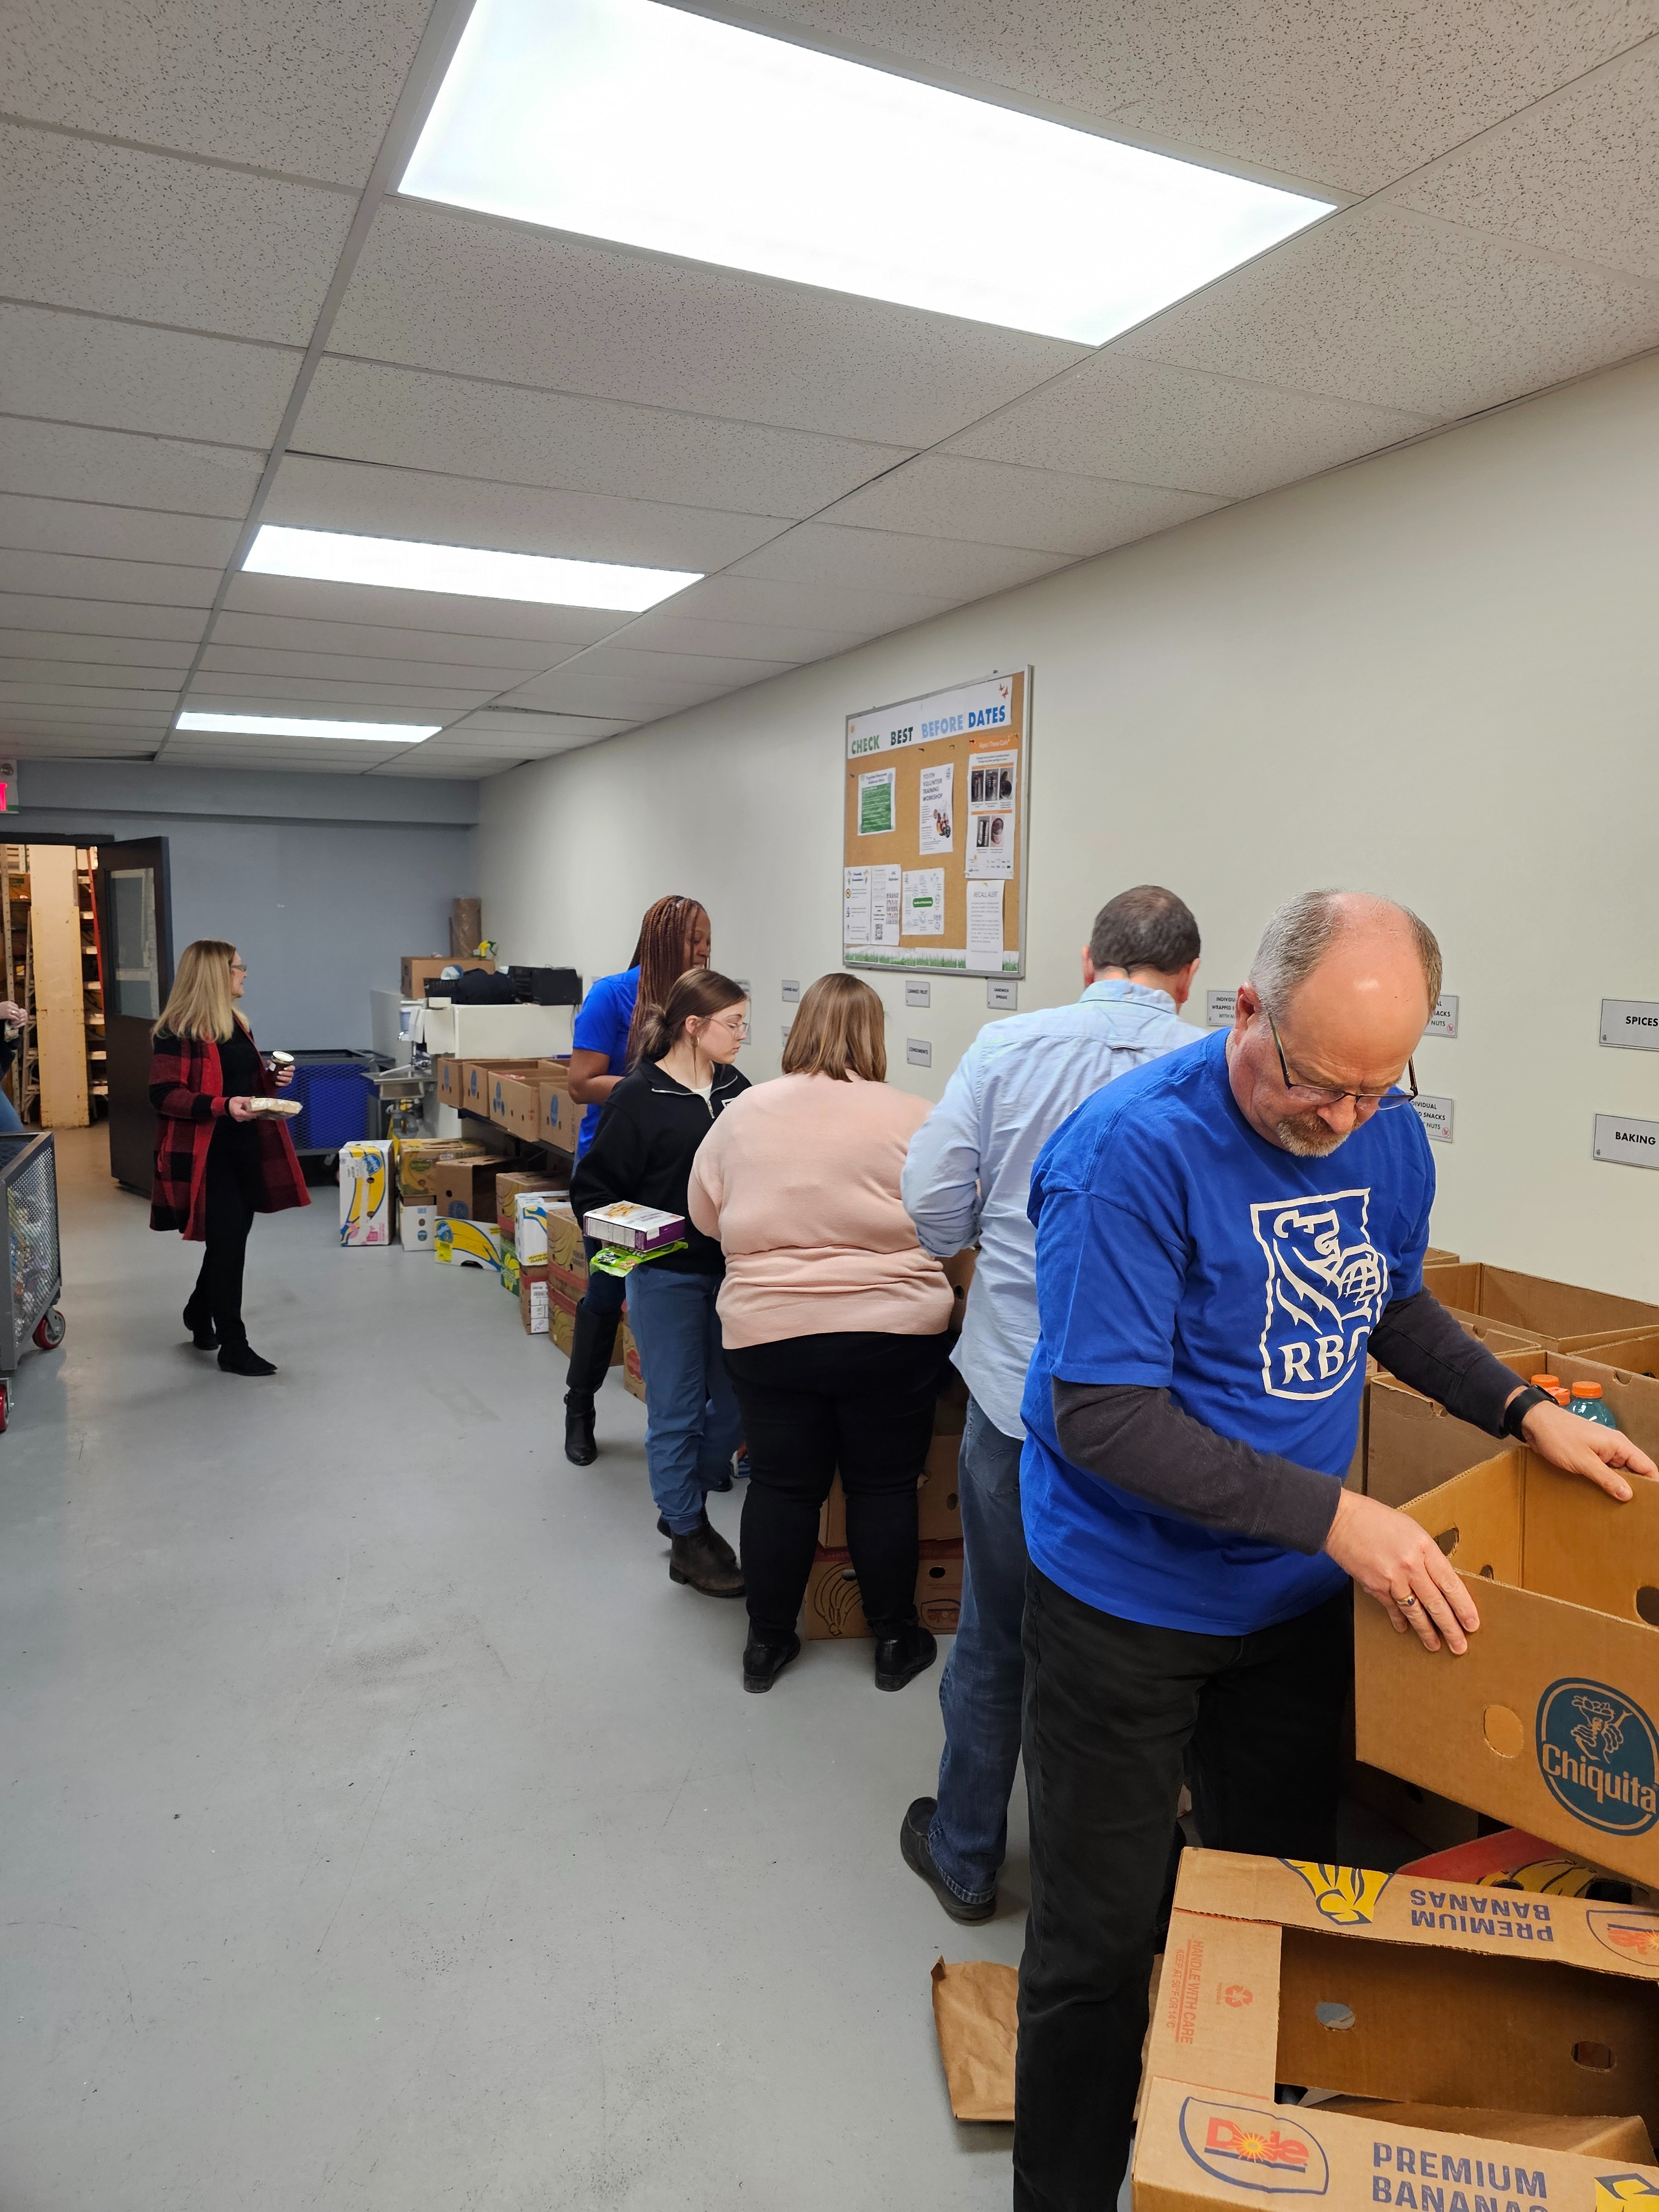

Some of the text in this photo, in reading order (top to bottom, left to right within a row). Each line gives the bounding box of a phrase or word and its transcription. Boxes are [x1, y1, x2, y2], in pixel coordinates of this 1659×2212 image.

[851, 705, 1005, 754] CHECK BEST BEFORE DATES
[922, 786, 939, 794] TRAINING
[923, 778, 942, 787] VOLUNTEER
[1626, 1016, 1658, 1027] SPICES
[1411, 1101, 1437, 1110] DIVIDUAL
[1615, 1132, 1656, 1145] BAKING
[1542, 1743, 1656, 1814] Chiquita
[1410, 1889, 1551, 1921] BANANAS
[1411, 1909, 1554, 1942] PREMIUM
[1175, 1949, 1185, 1969] KEEP
[1172, 1969, 1182, 1979] AT
[1180, 1939, 1204, 2044] HANDLE WITH CARE
[1169, 1997, 1178, 2010] OR
[1206, 2116, 1310, 2164] Dole
[1373, 2142, 1547, 2199] PREMIUM
